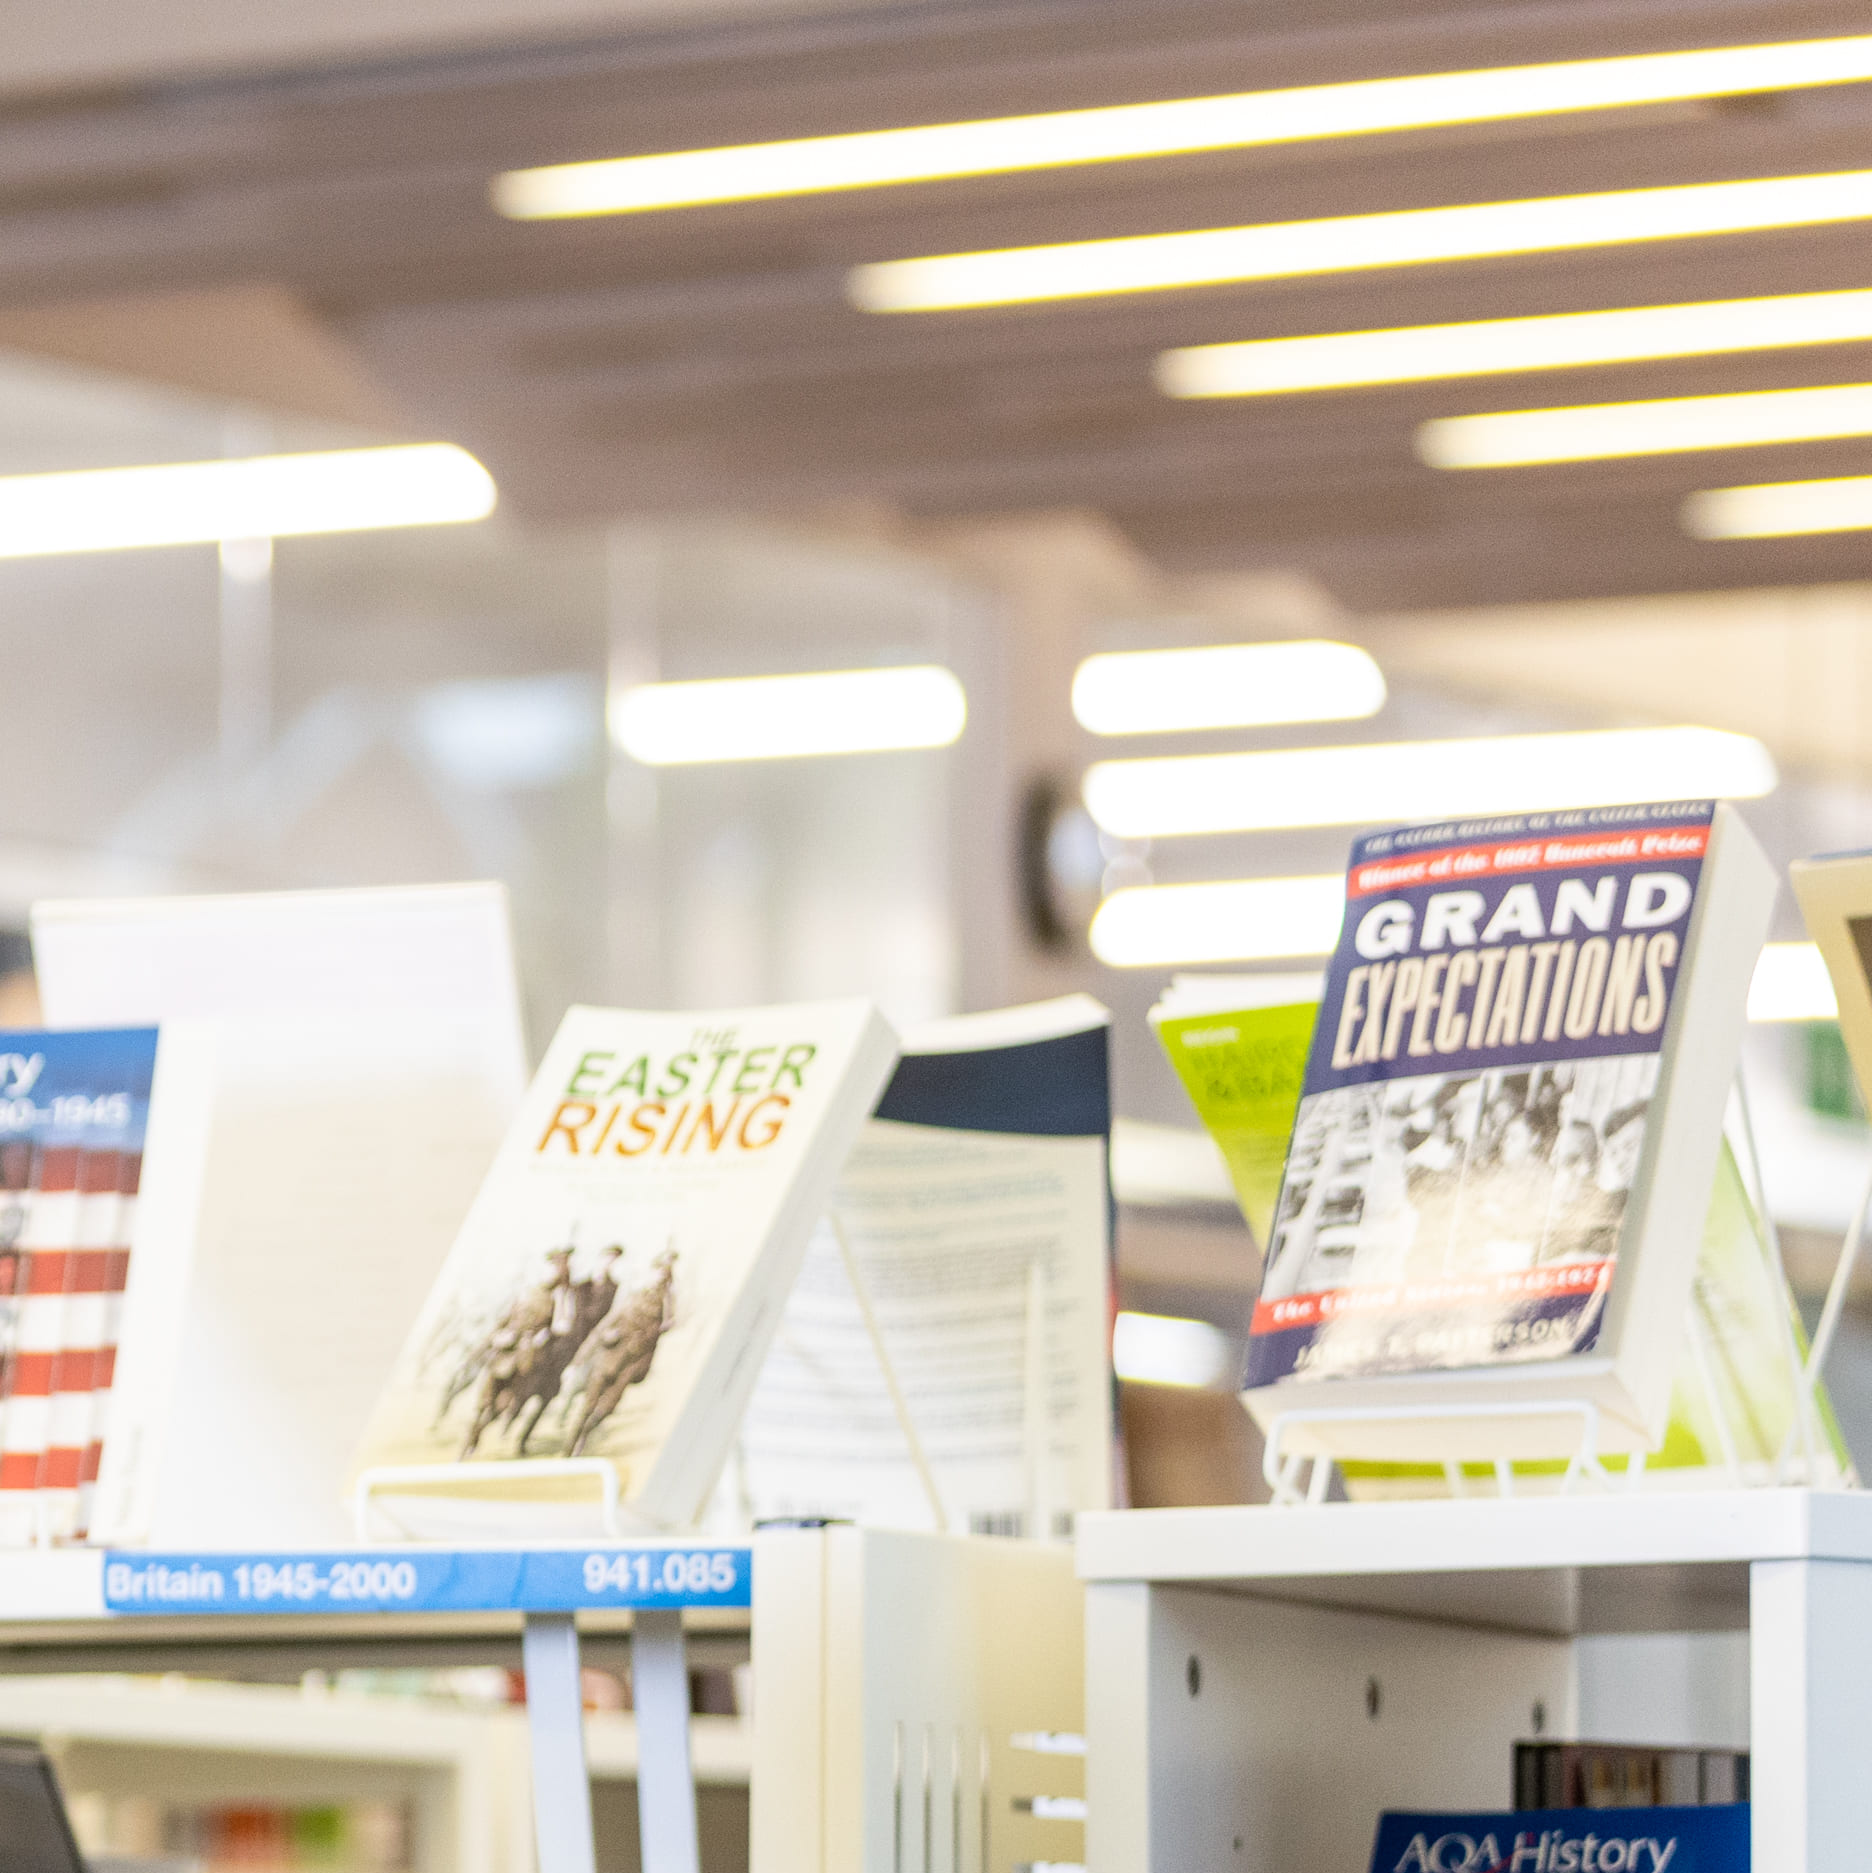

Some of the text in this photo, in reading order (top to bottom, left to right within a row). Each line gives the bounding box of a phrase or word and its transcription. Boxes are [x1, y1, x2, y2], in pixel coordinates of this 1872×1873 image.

[1355, 871, 1693, 961] GRAND
[1332, 930, 1679, 1071] EXPECTATIONS
[566, 1043, 818, 1099] EASTER
[535, 1094, 792, 1158] RISING
[106, 1552, 736, 1602] Britain 1945-2000 941.085
